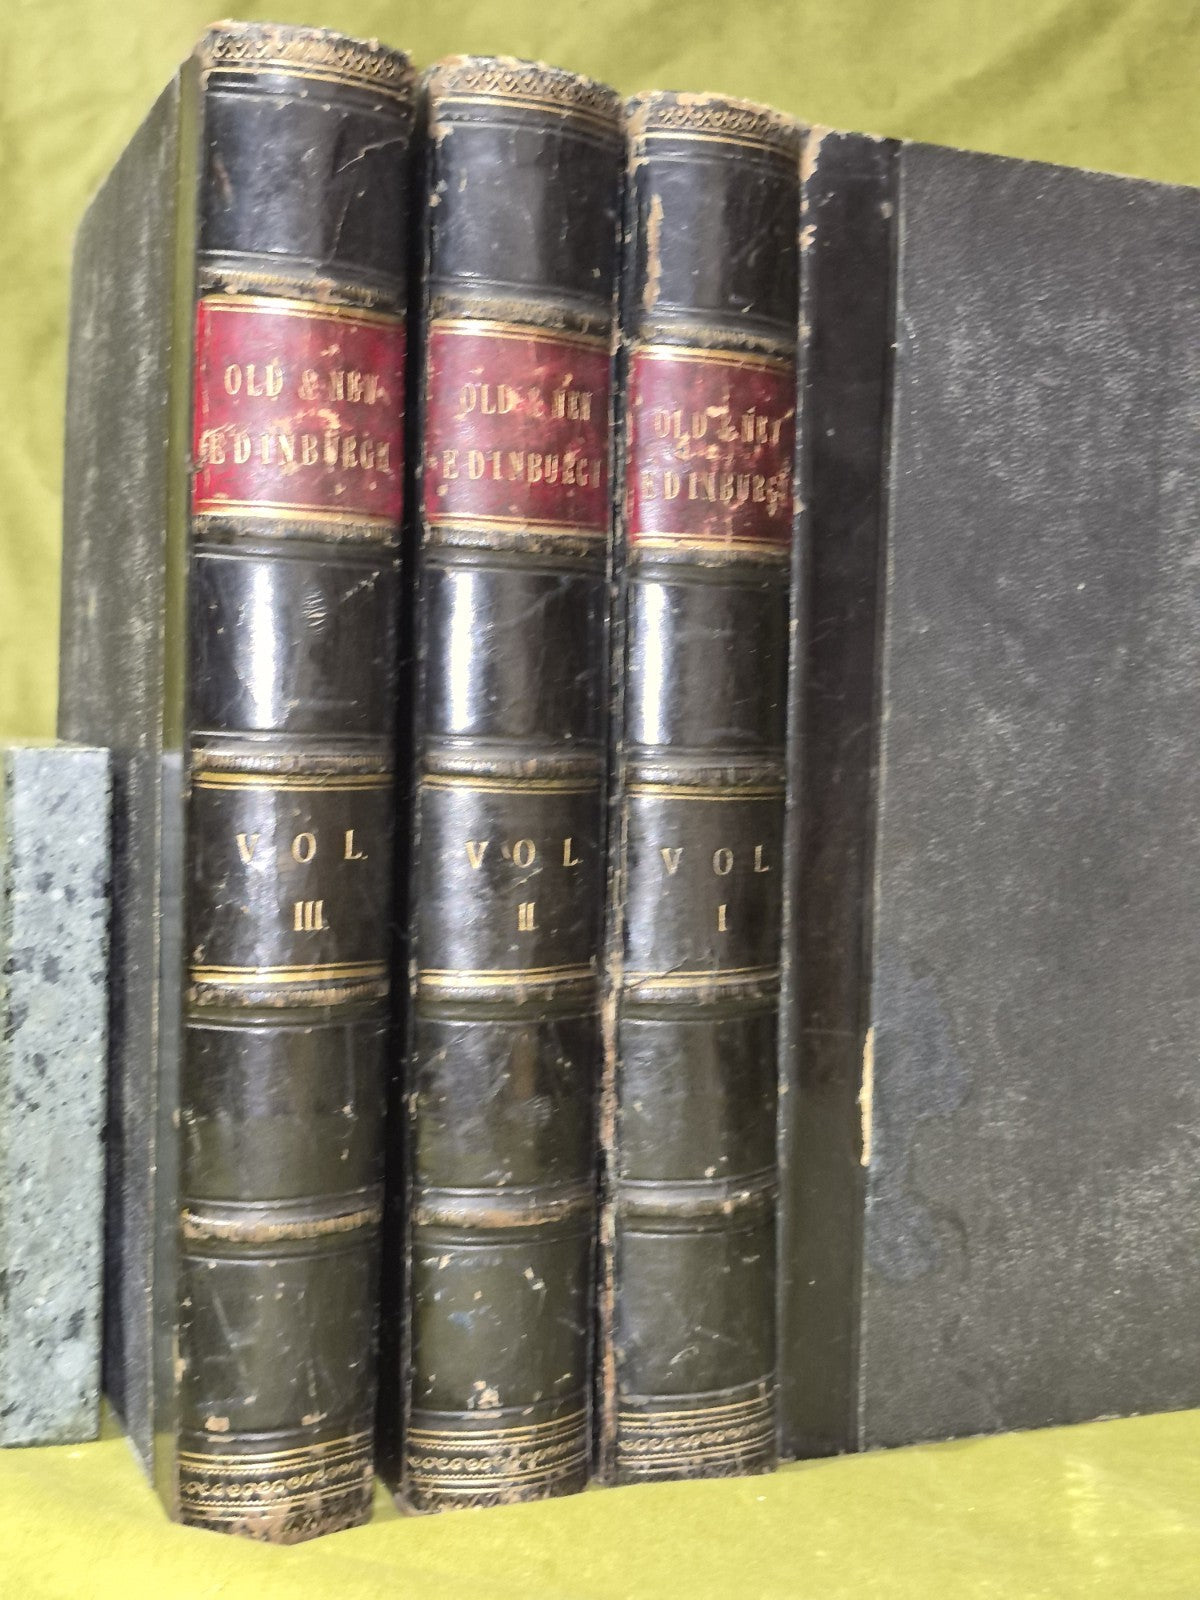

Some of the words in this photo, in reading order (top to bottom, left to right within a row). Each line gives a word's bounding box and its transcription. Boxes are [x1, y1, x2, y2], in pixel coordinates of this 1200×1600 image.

[223, 363, 284, 397] OLD
[298, 368, 321, 401] &
[459, 382, 514, 415] OLD
[654, 410, 709, 439] OLD
[207, 431, 391, 473] EDINBURGH
[642, 470, 788, 507] EDINBUR
[660, 844, 770, 875] VOL
[517, 901, 538, 932] II
[718, 904, 728, 932] I
